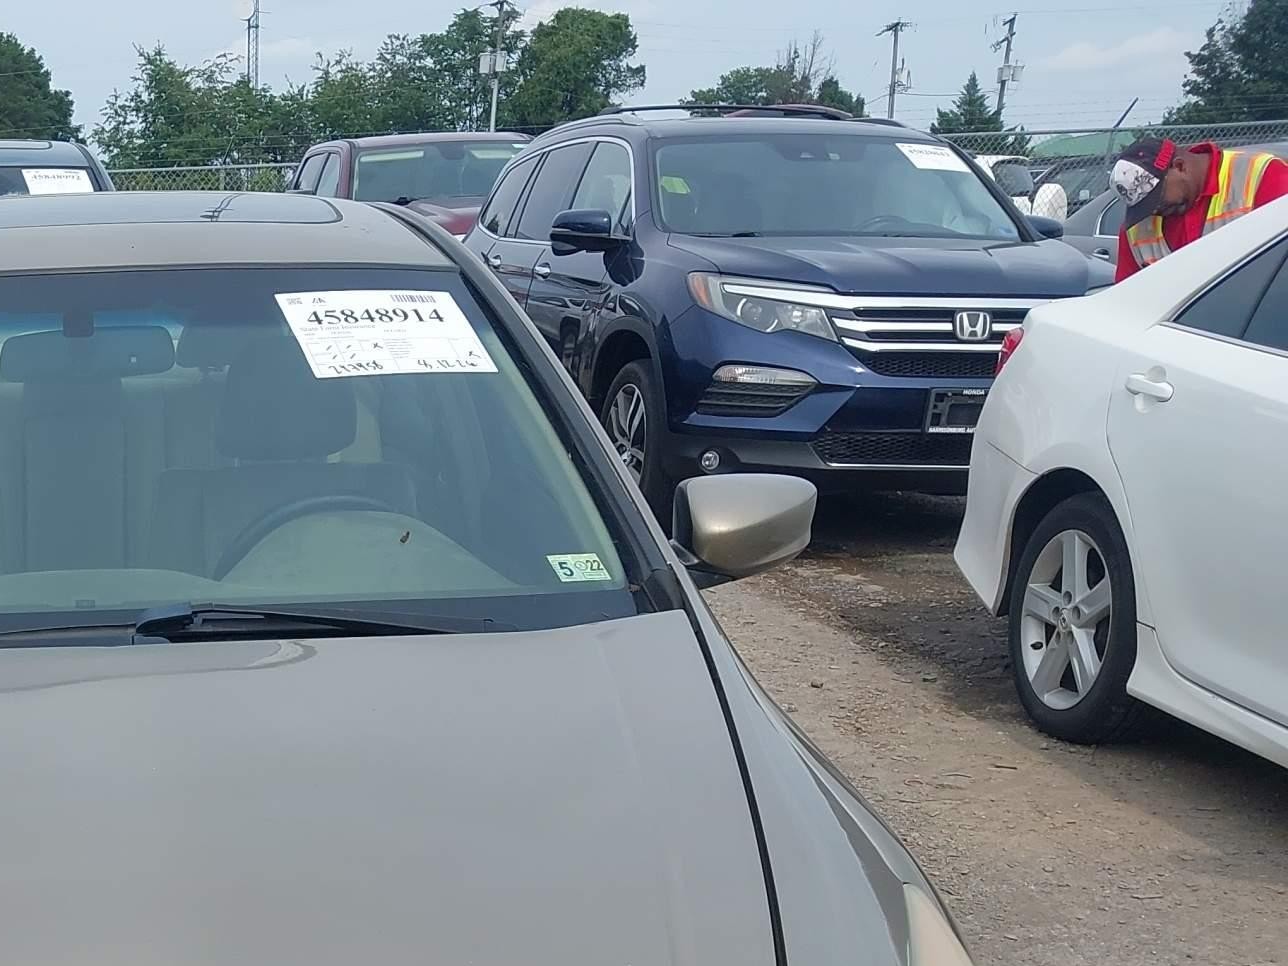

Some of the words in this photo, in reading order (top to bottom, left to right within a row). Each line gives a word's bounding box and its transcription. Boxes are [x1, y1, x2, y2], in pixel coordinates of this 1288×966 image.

[307, 308, 445, 325] 45848914
[558, 561, 574, 577] 5
[585, 559, 604, 571] 22
